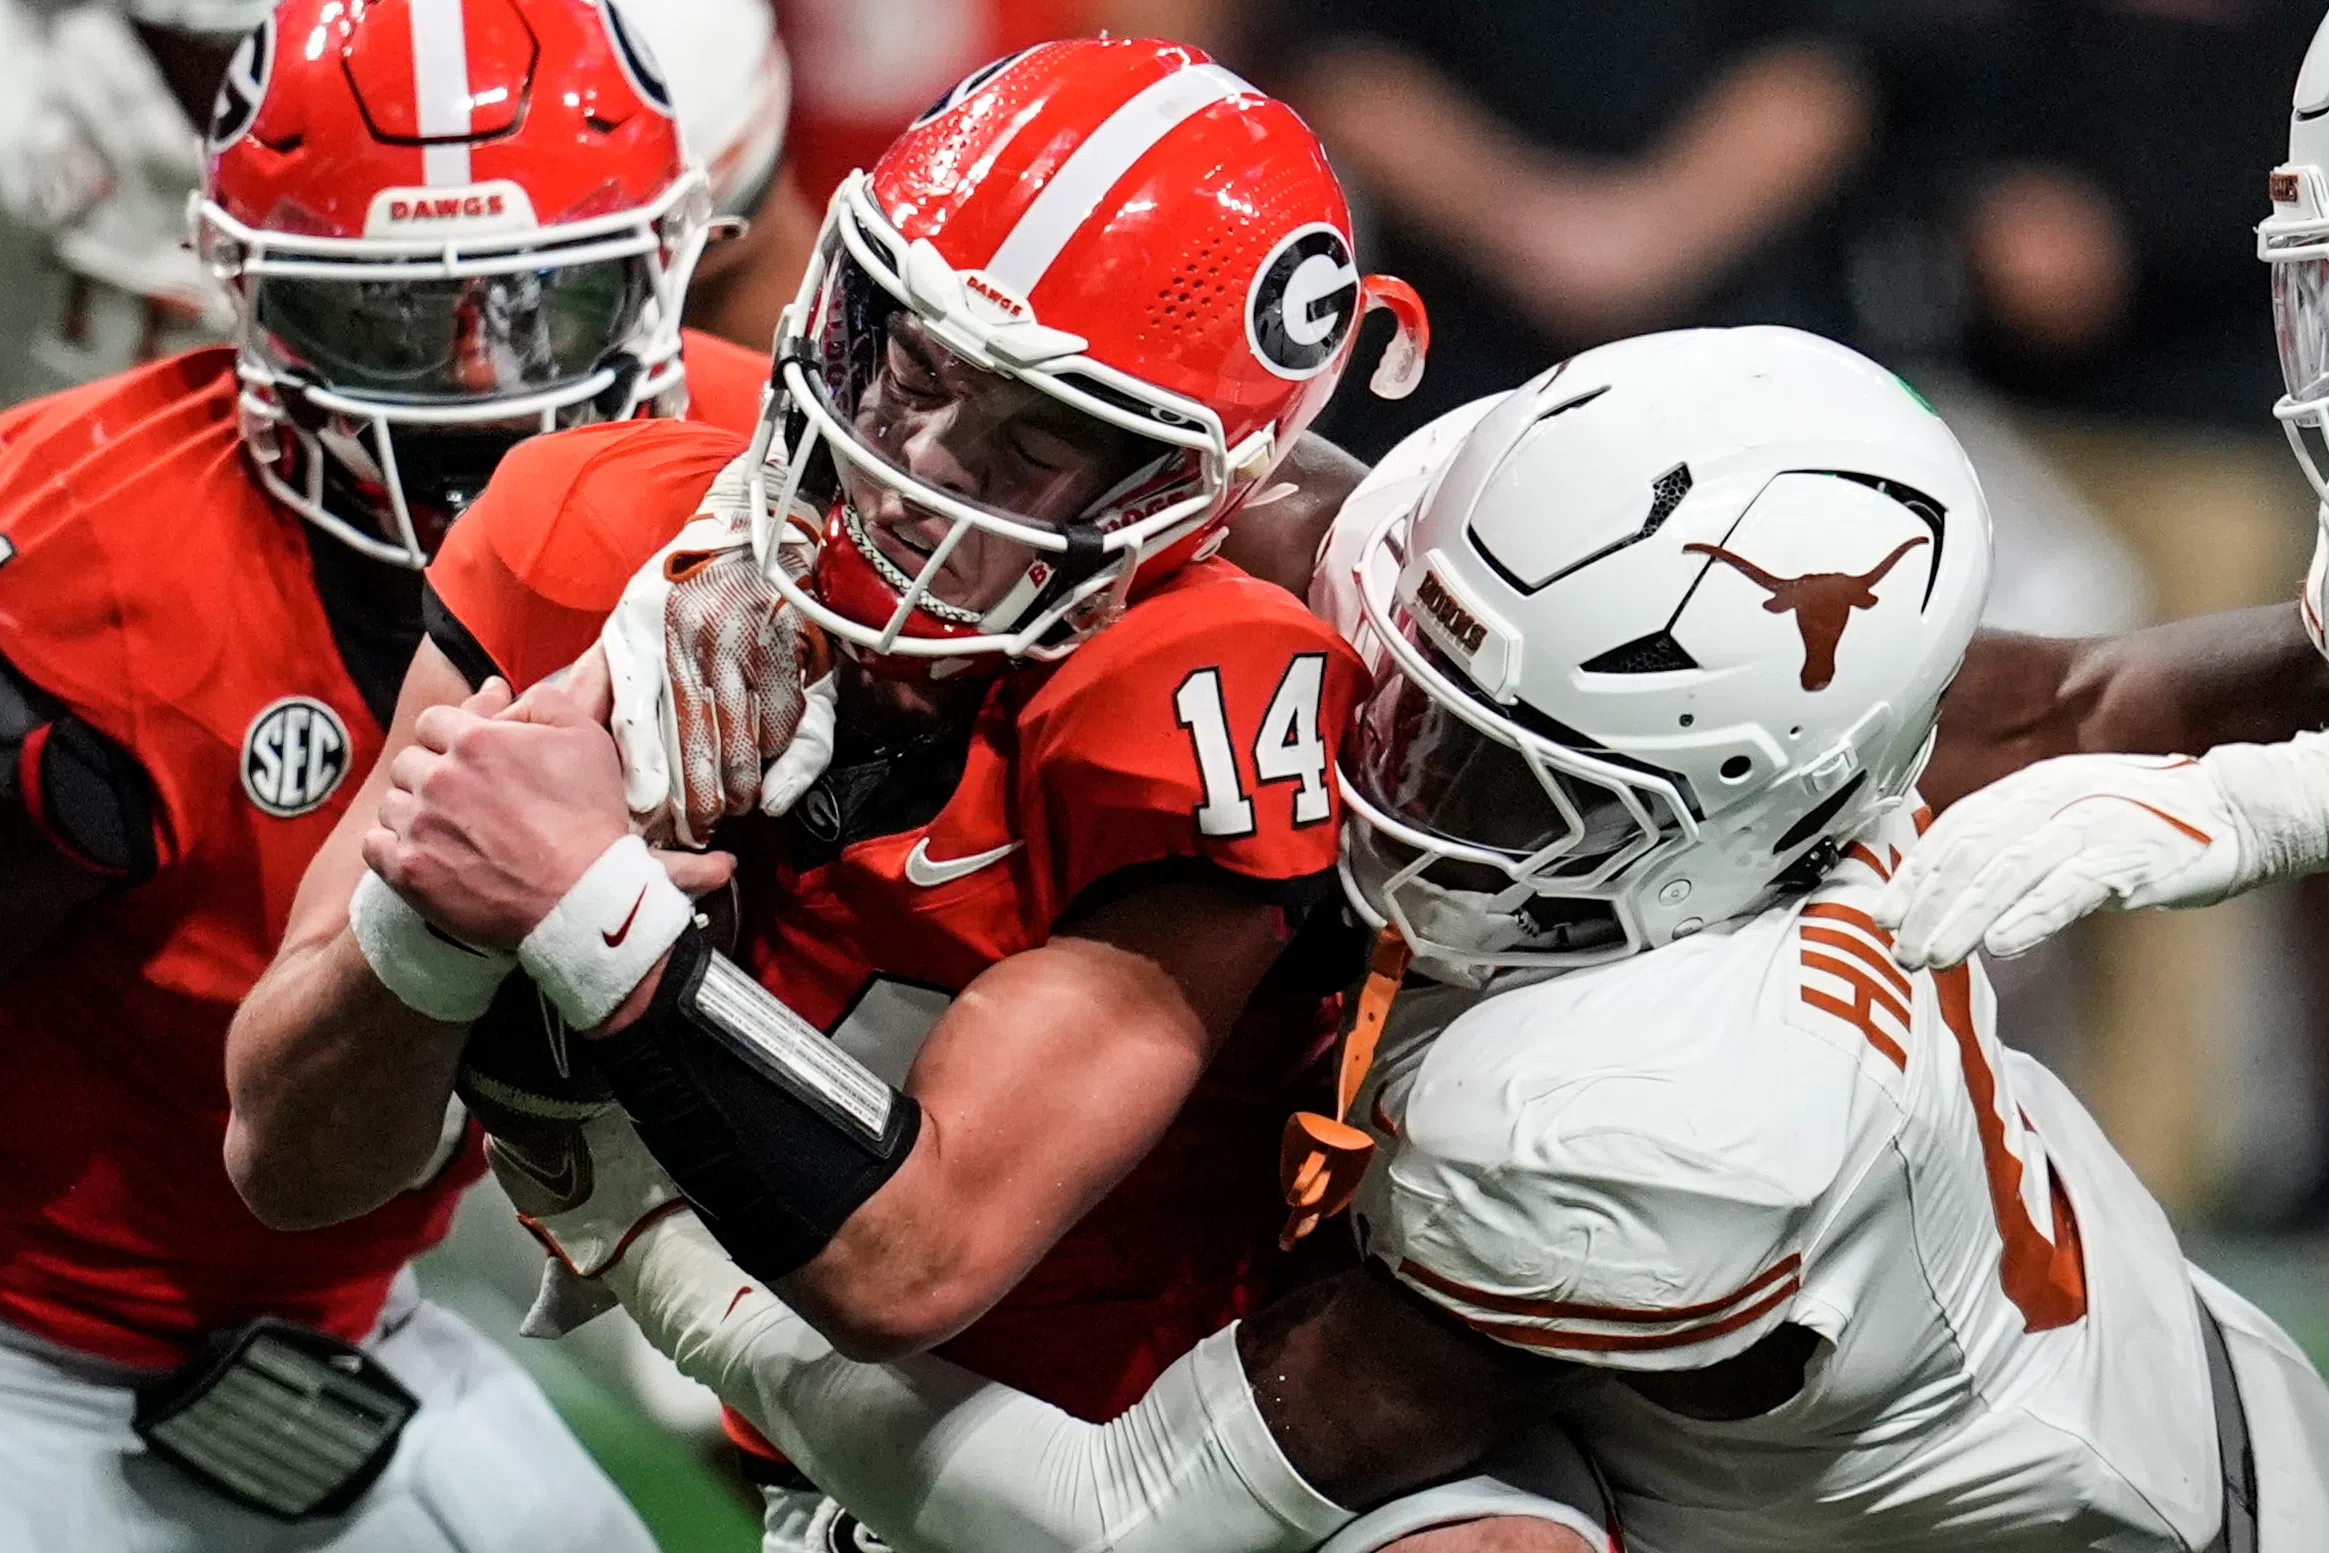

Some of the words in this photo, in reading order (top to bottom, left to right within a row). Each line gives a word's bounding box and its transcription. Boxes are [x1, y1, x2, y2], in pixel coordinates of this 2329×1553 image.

[390, 195, 504, 222] DAWGS
[966, 276, 1023, 316] DAWGS
[252, 707, 342, 806] SEC
[1172, 652, 1331, 838] 14
